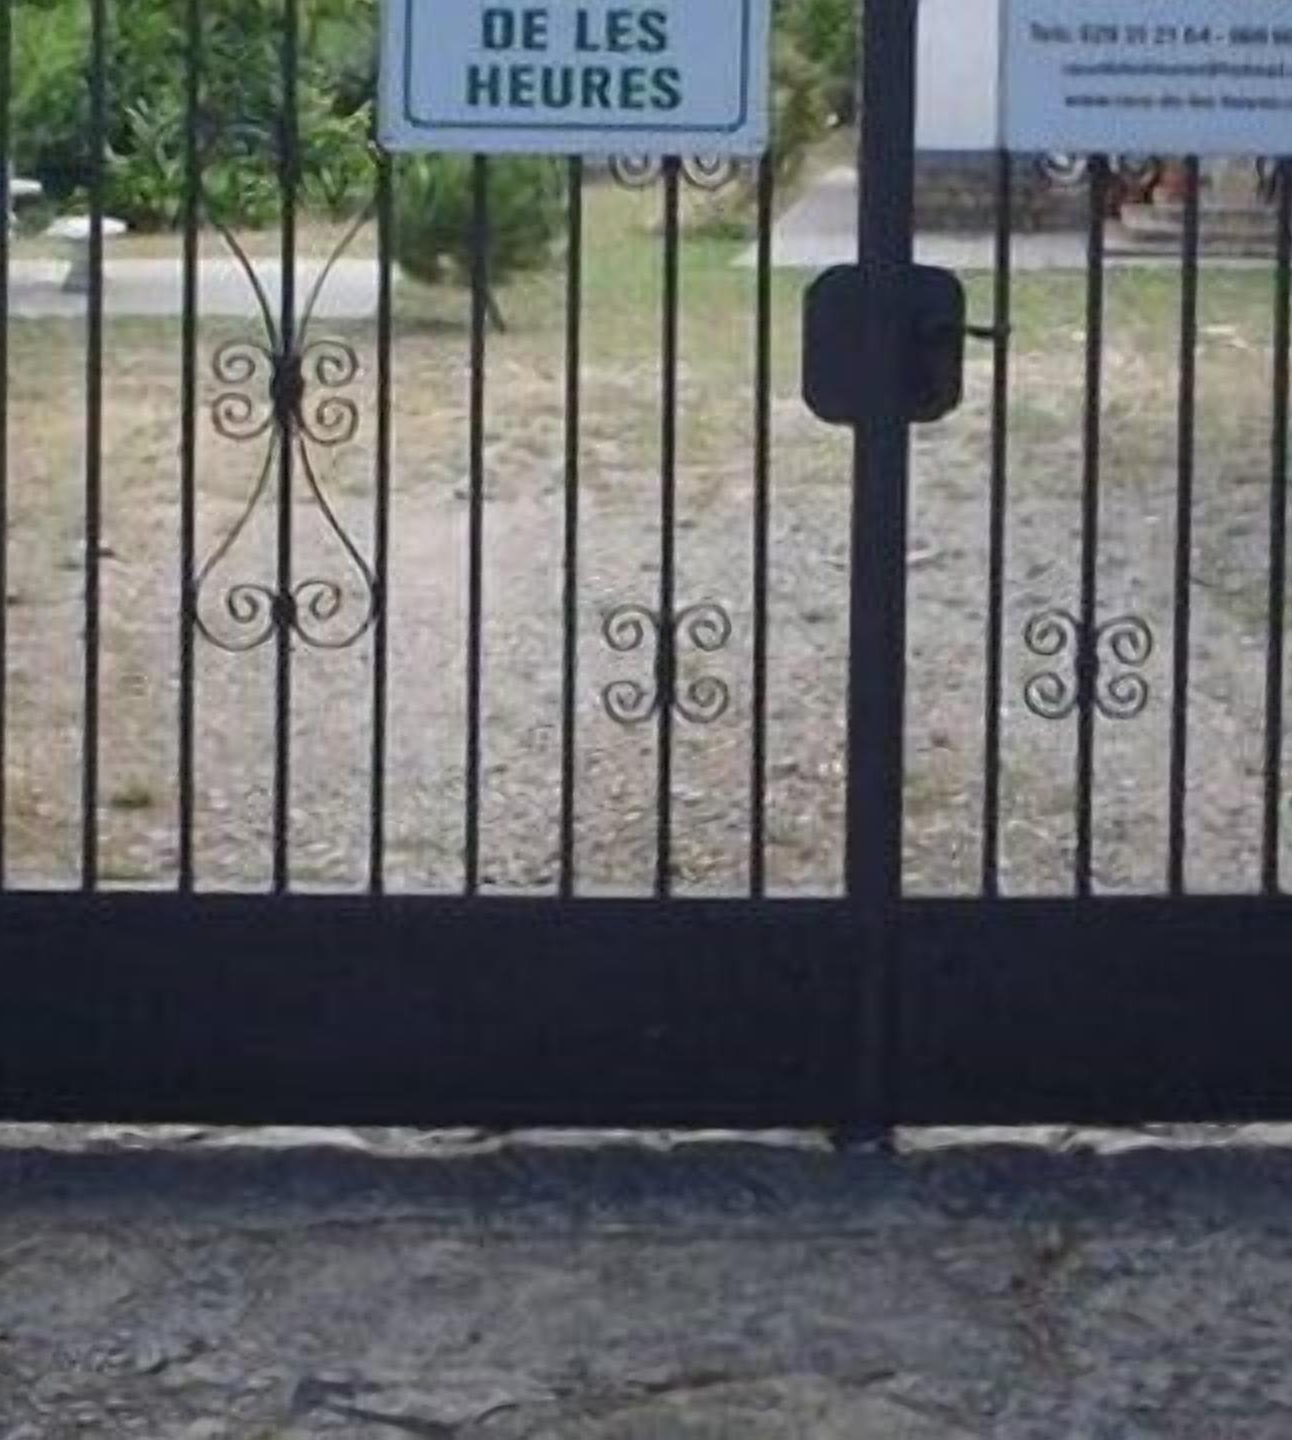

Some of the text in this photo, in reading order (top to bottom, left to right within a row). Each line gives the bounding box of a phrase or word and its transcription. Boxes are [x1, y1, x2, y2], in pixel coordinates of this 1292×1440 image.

[481, 9, 668, 52] DE LES
[466, 64, 682, 110] HEURES
